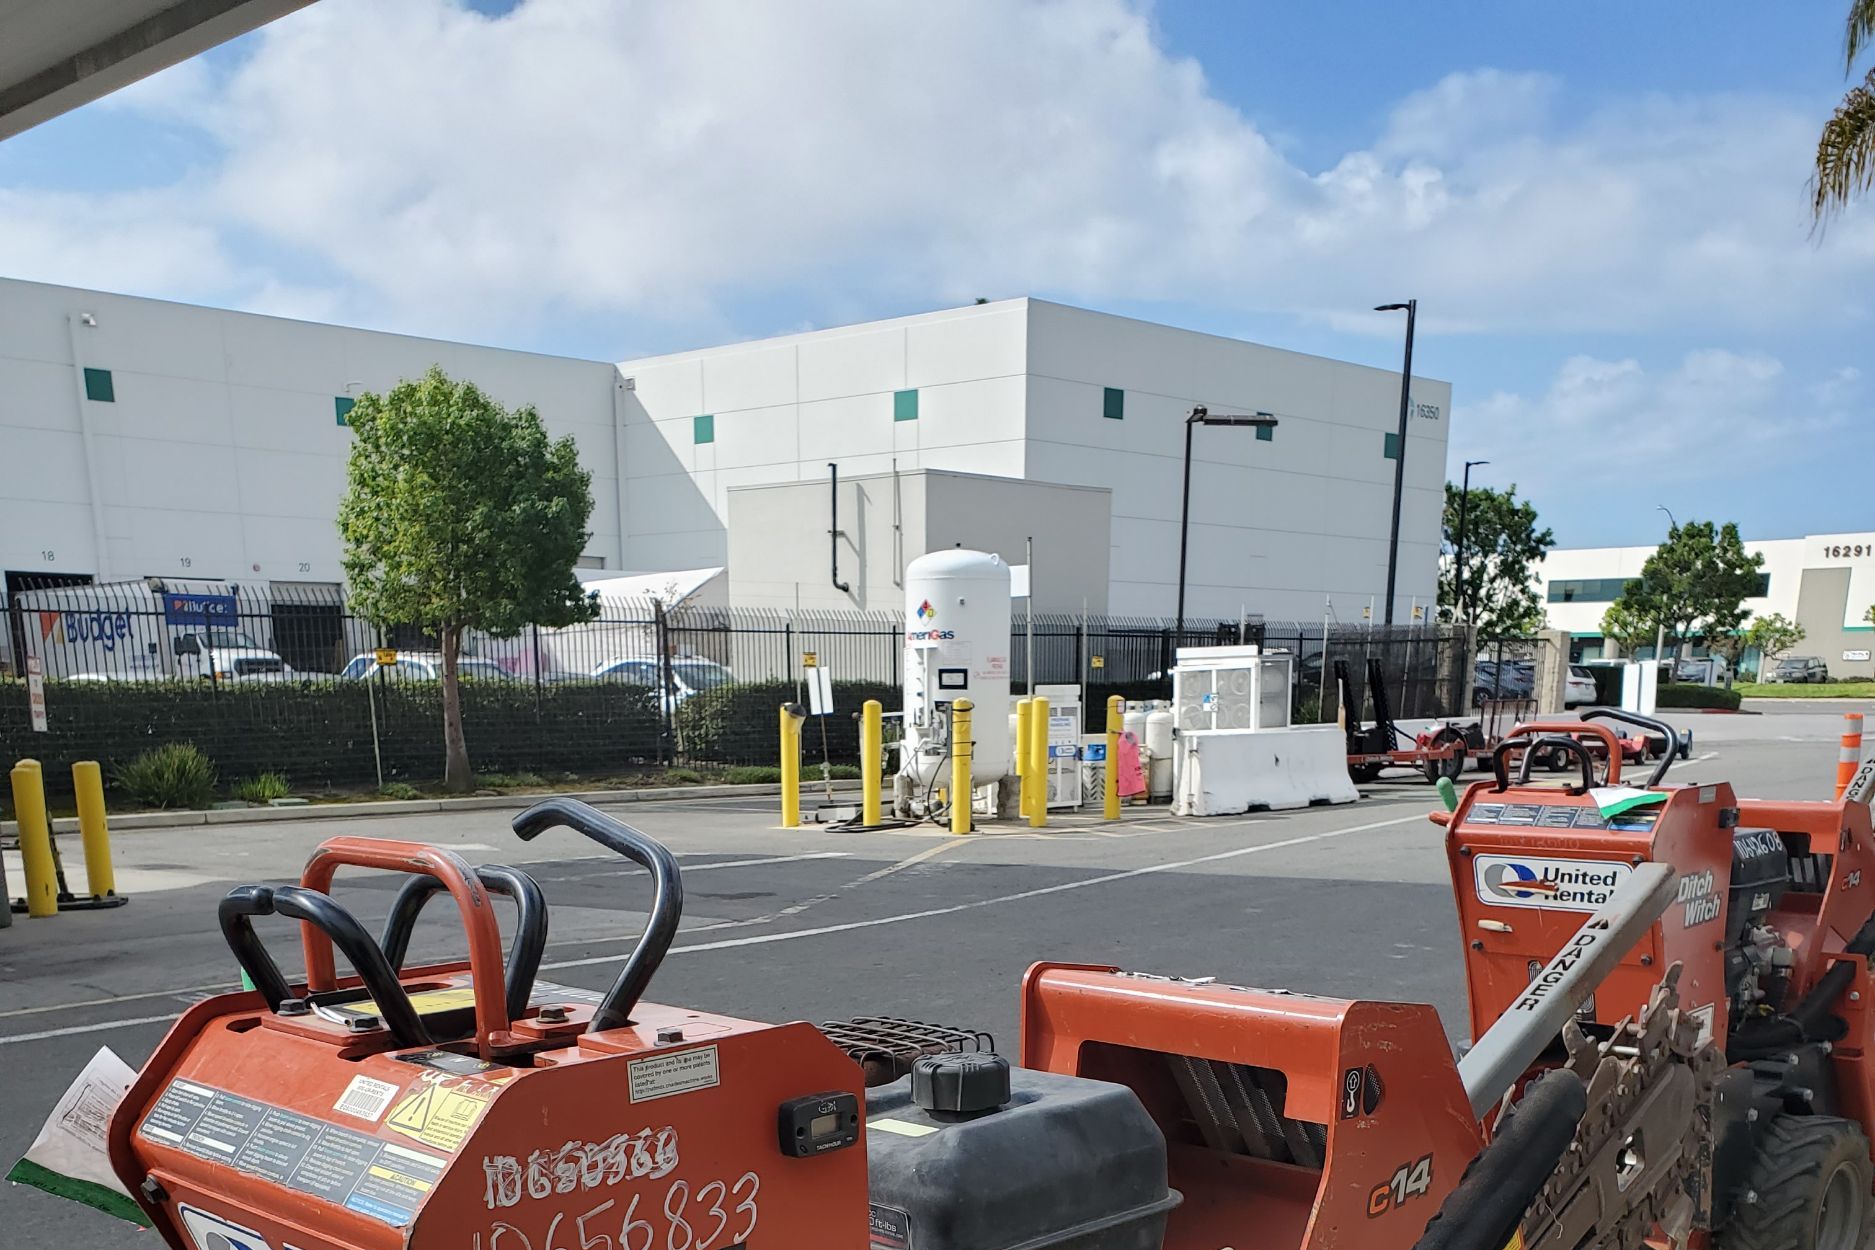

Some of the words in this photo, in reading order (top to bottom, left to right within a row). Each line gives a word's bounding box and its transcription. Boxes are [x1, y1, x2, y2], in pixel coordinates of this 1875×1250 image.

[42, 551, 54, 561] 18
[1824, 545, 1872, 558] 16291
[180, 557, 191, 567] 19
[299, 562, 310, 572] 20
[1543, 867, 1618, 887] United
[1677, 870, 1713, 902] Ditch
[1685, 894, 1721, 927] Witch
[1515, 934, 1597, 1011] DANGER
